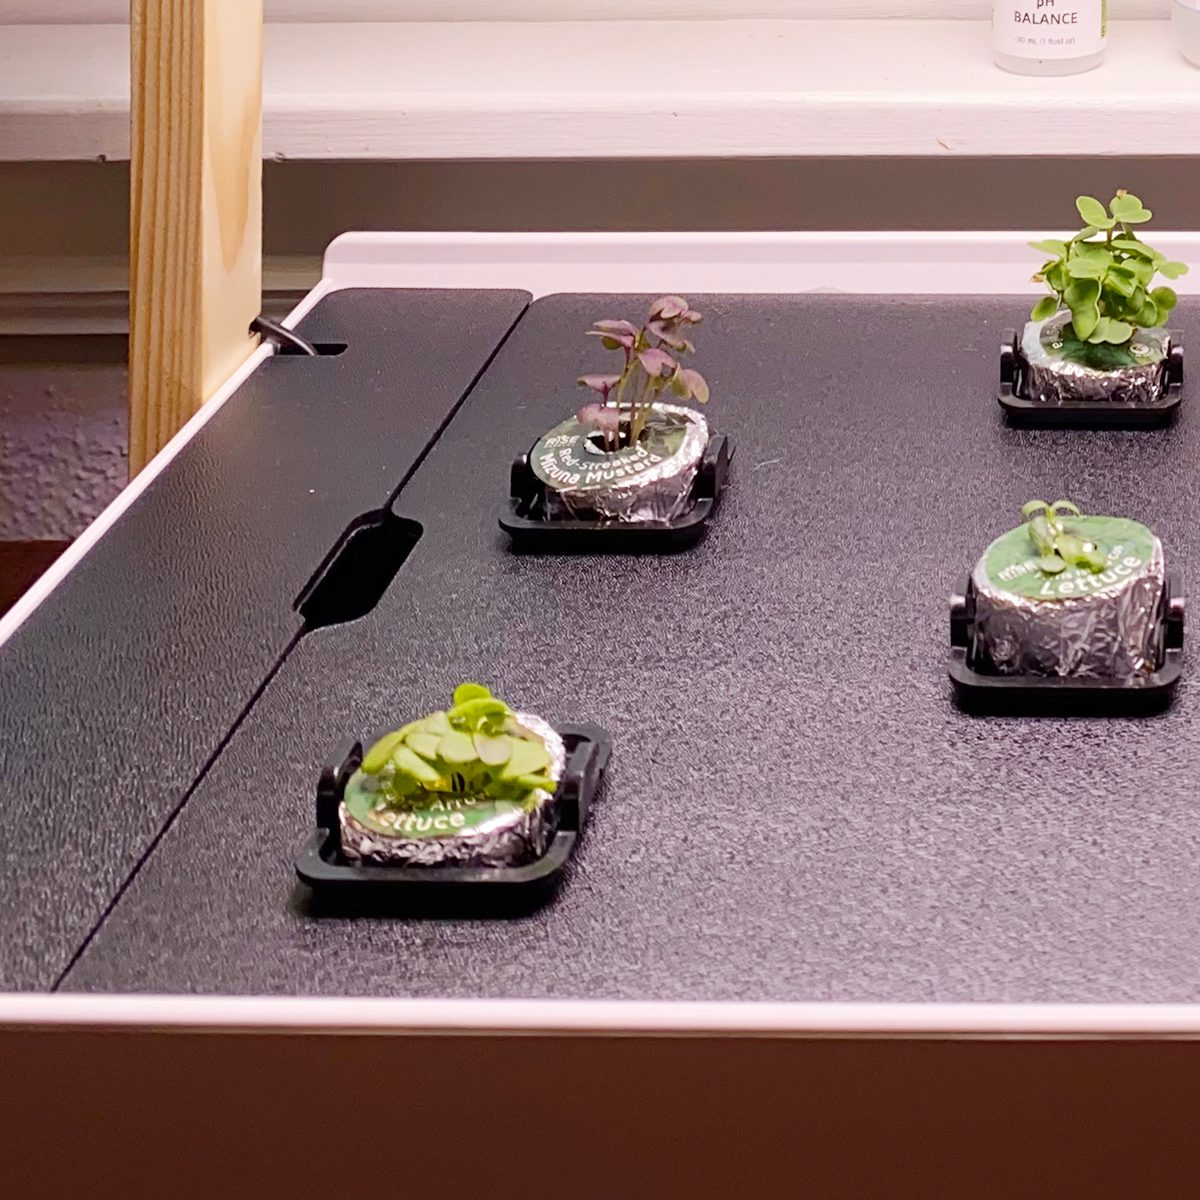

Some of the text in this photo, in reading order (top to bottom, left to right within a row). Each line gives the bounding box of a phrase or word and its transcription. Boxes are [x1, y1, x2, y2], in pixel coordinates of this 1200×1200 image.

[1014, 11, 1078, 25] BALANCE
[539, 453, 662, 485] Mizuna Mustard
[558, 442, 648, 471] Red-Streaked
[1040, 554, 1142, 596] Lettuce
